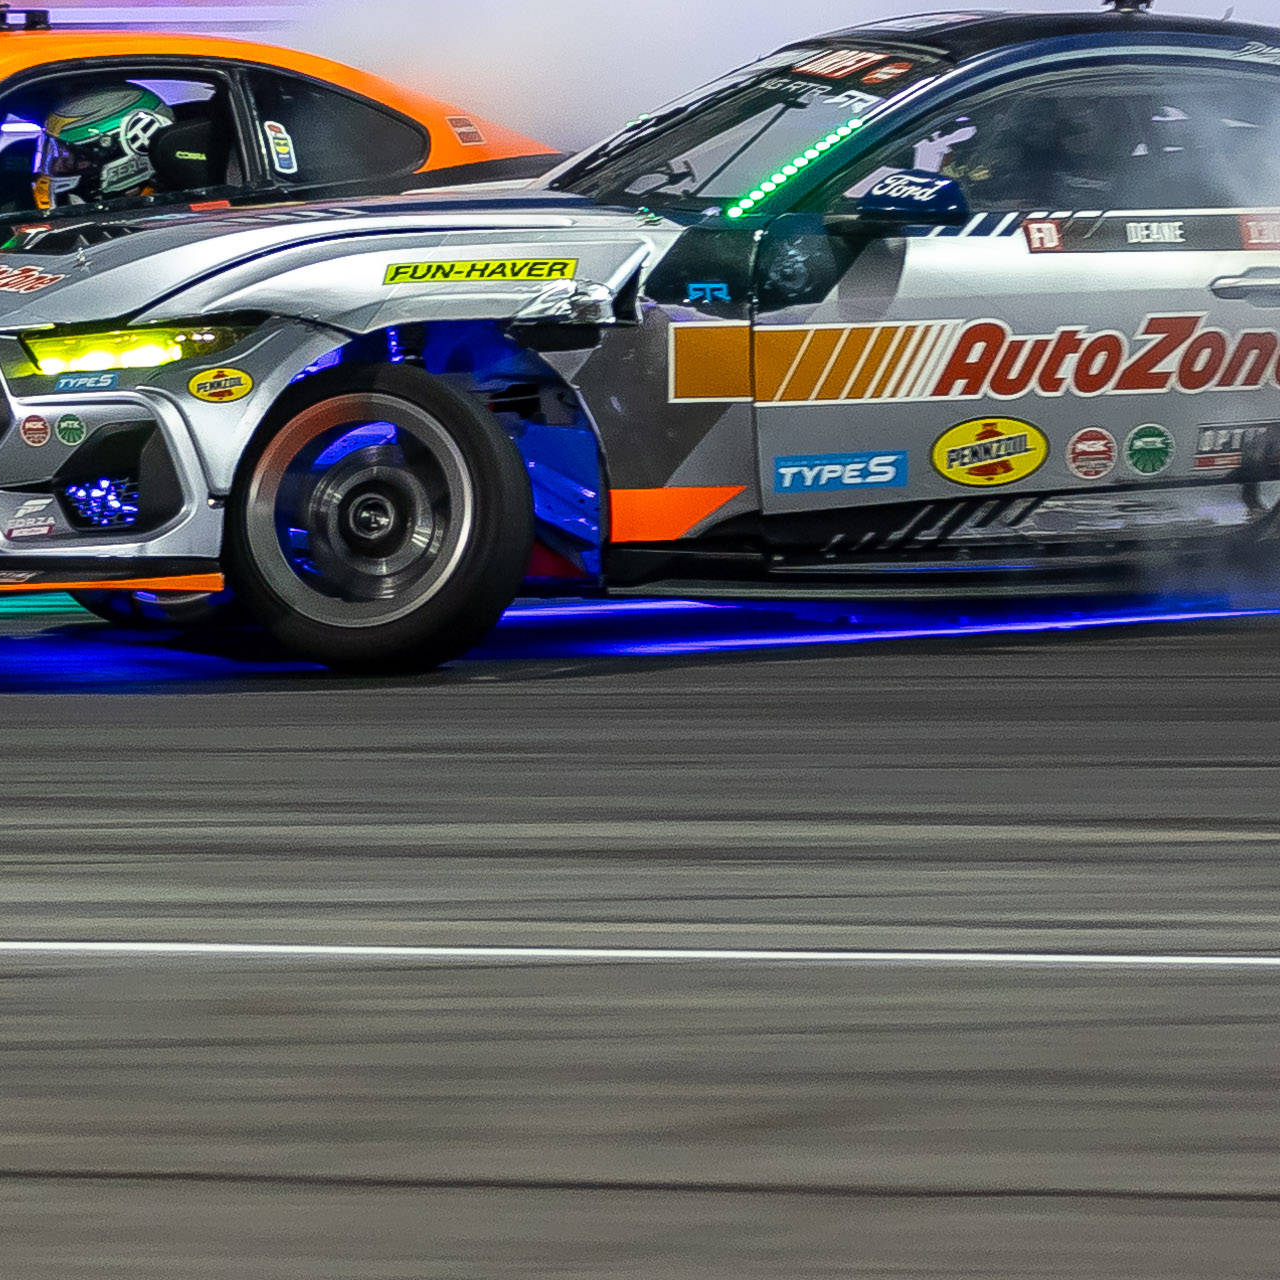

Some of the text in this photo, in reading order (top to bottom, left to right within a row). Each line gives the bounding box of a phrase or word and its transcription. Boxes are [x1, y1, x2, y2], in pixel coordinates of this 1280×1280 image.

[872, 175, 952, 201] Ford
[389, 261, 570, 282] FUN-HAVER
[947, 433, 1028, 469] PENNZOIL
